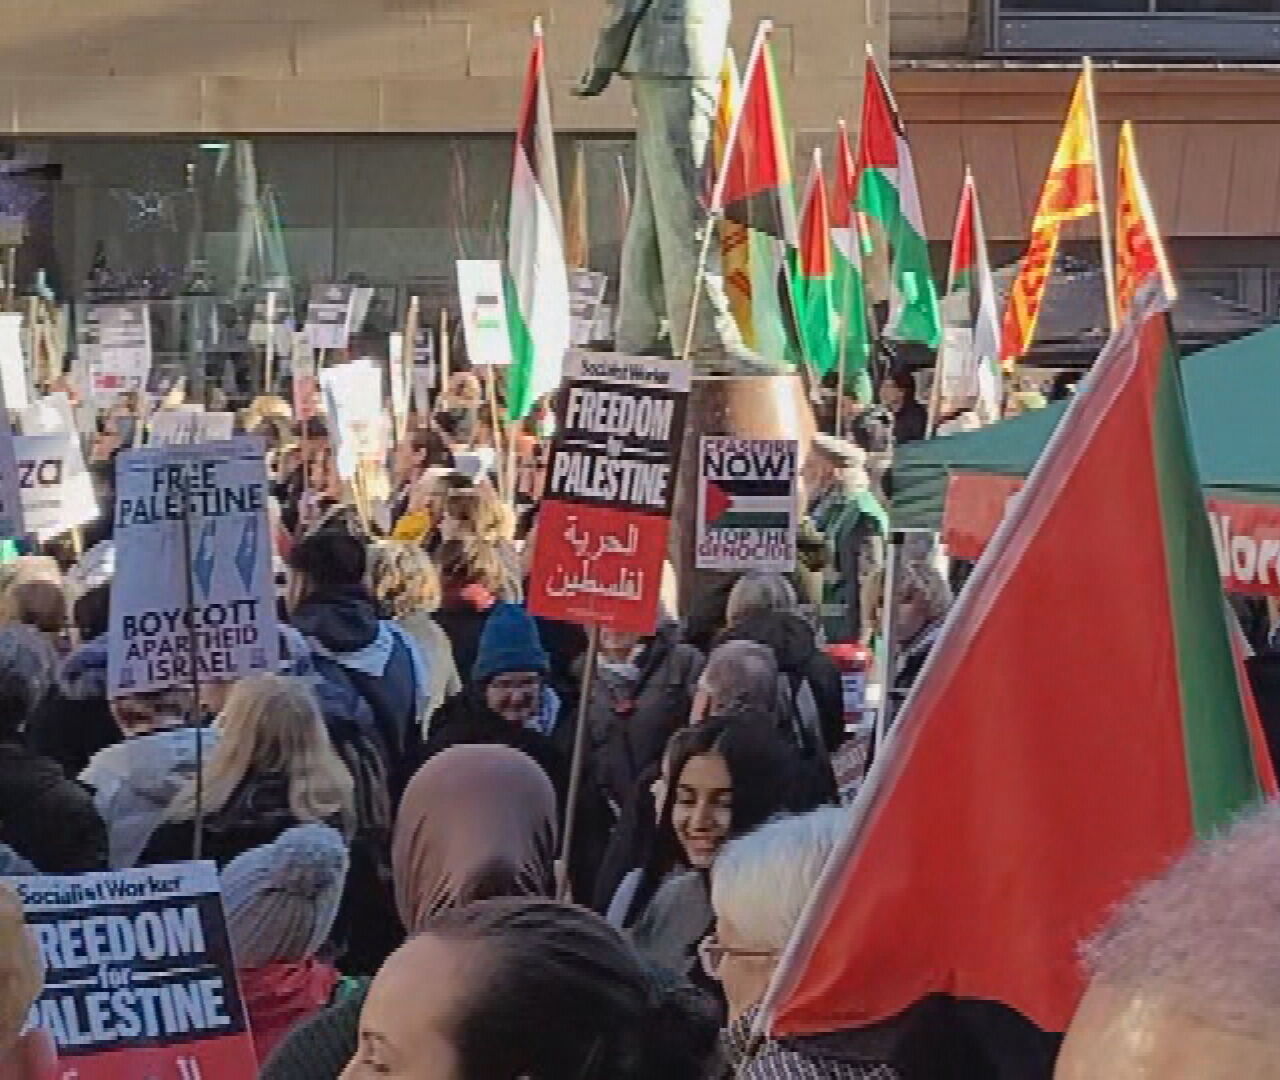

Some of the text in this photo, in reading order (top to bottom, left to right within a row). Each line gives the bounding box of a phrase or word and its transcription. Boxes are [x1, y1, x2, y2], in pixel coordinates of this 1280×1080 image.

[565, 388, 674, 441] FREEDOM
[19, 459, 61, 488] za
[152, 463, 217, 493] FREE
[551, 451, 671, 505] PALESTINE
[703, 454, 795, 477] NOW!
[117, 484, 262, 528] PALESTINE
[563, 515, 639, 561] الحرية
[545, 560, 645, 601] لفلسطين
[122, 600, 258, 640] BOYCOTT
[126, 625, 258, 661] APARTHEID
[147, 651, 238, 684] ISRAEL
[18, 875, 182, 905] Socialist Worker
[27, 907, 207, 969] REEDOM
[98, 963, 132, 989] for
